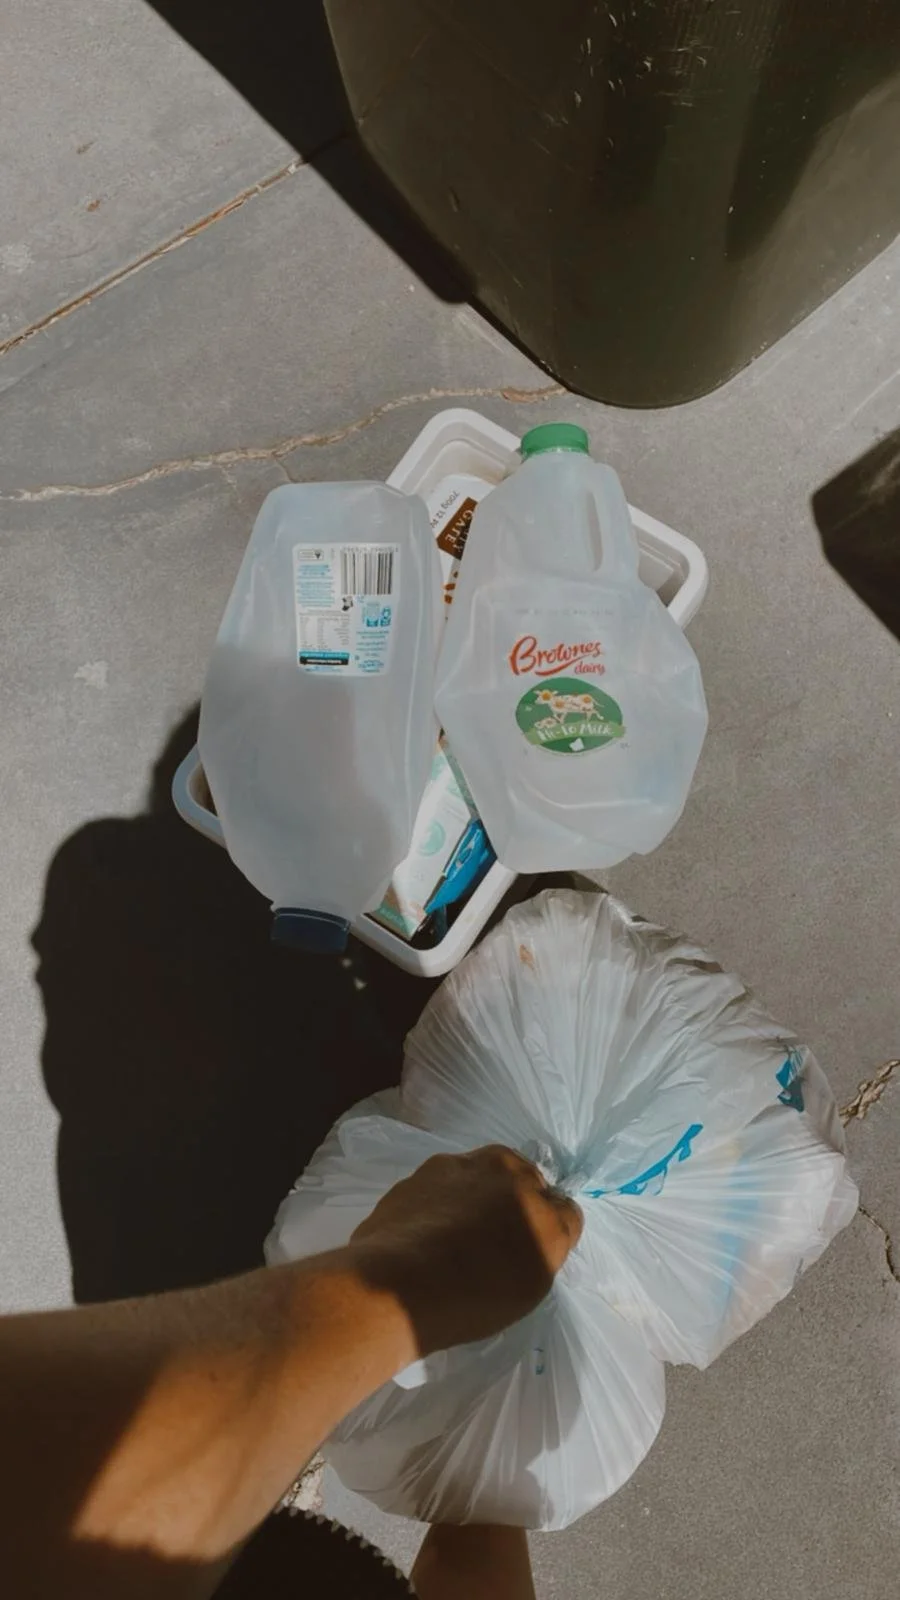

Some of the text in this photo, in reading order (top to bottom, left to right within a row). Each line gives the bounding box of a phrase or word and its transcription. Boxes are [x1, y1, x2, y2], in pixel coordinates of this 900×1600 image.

[445, 509, 474, 544] GATE
[509, 635, 603, 676] Brownes
[574, 661, 606, 676] dairy
